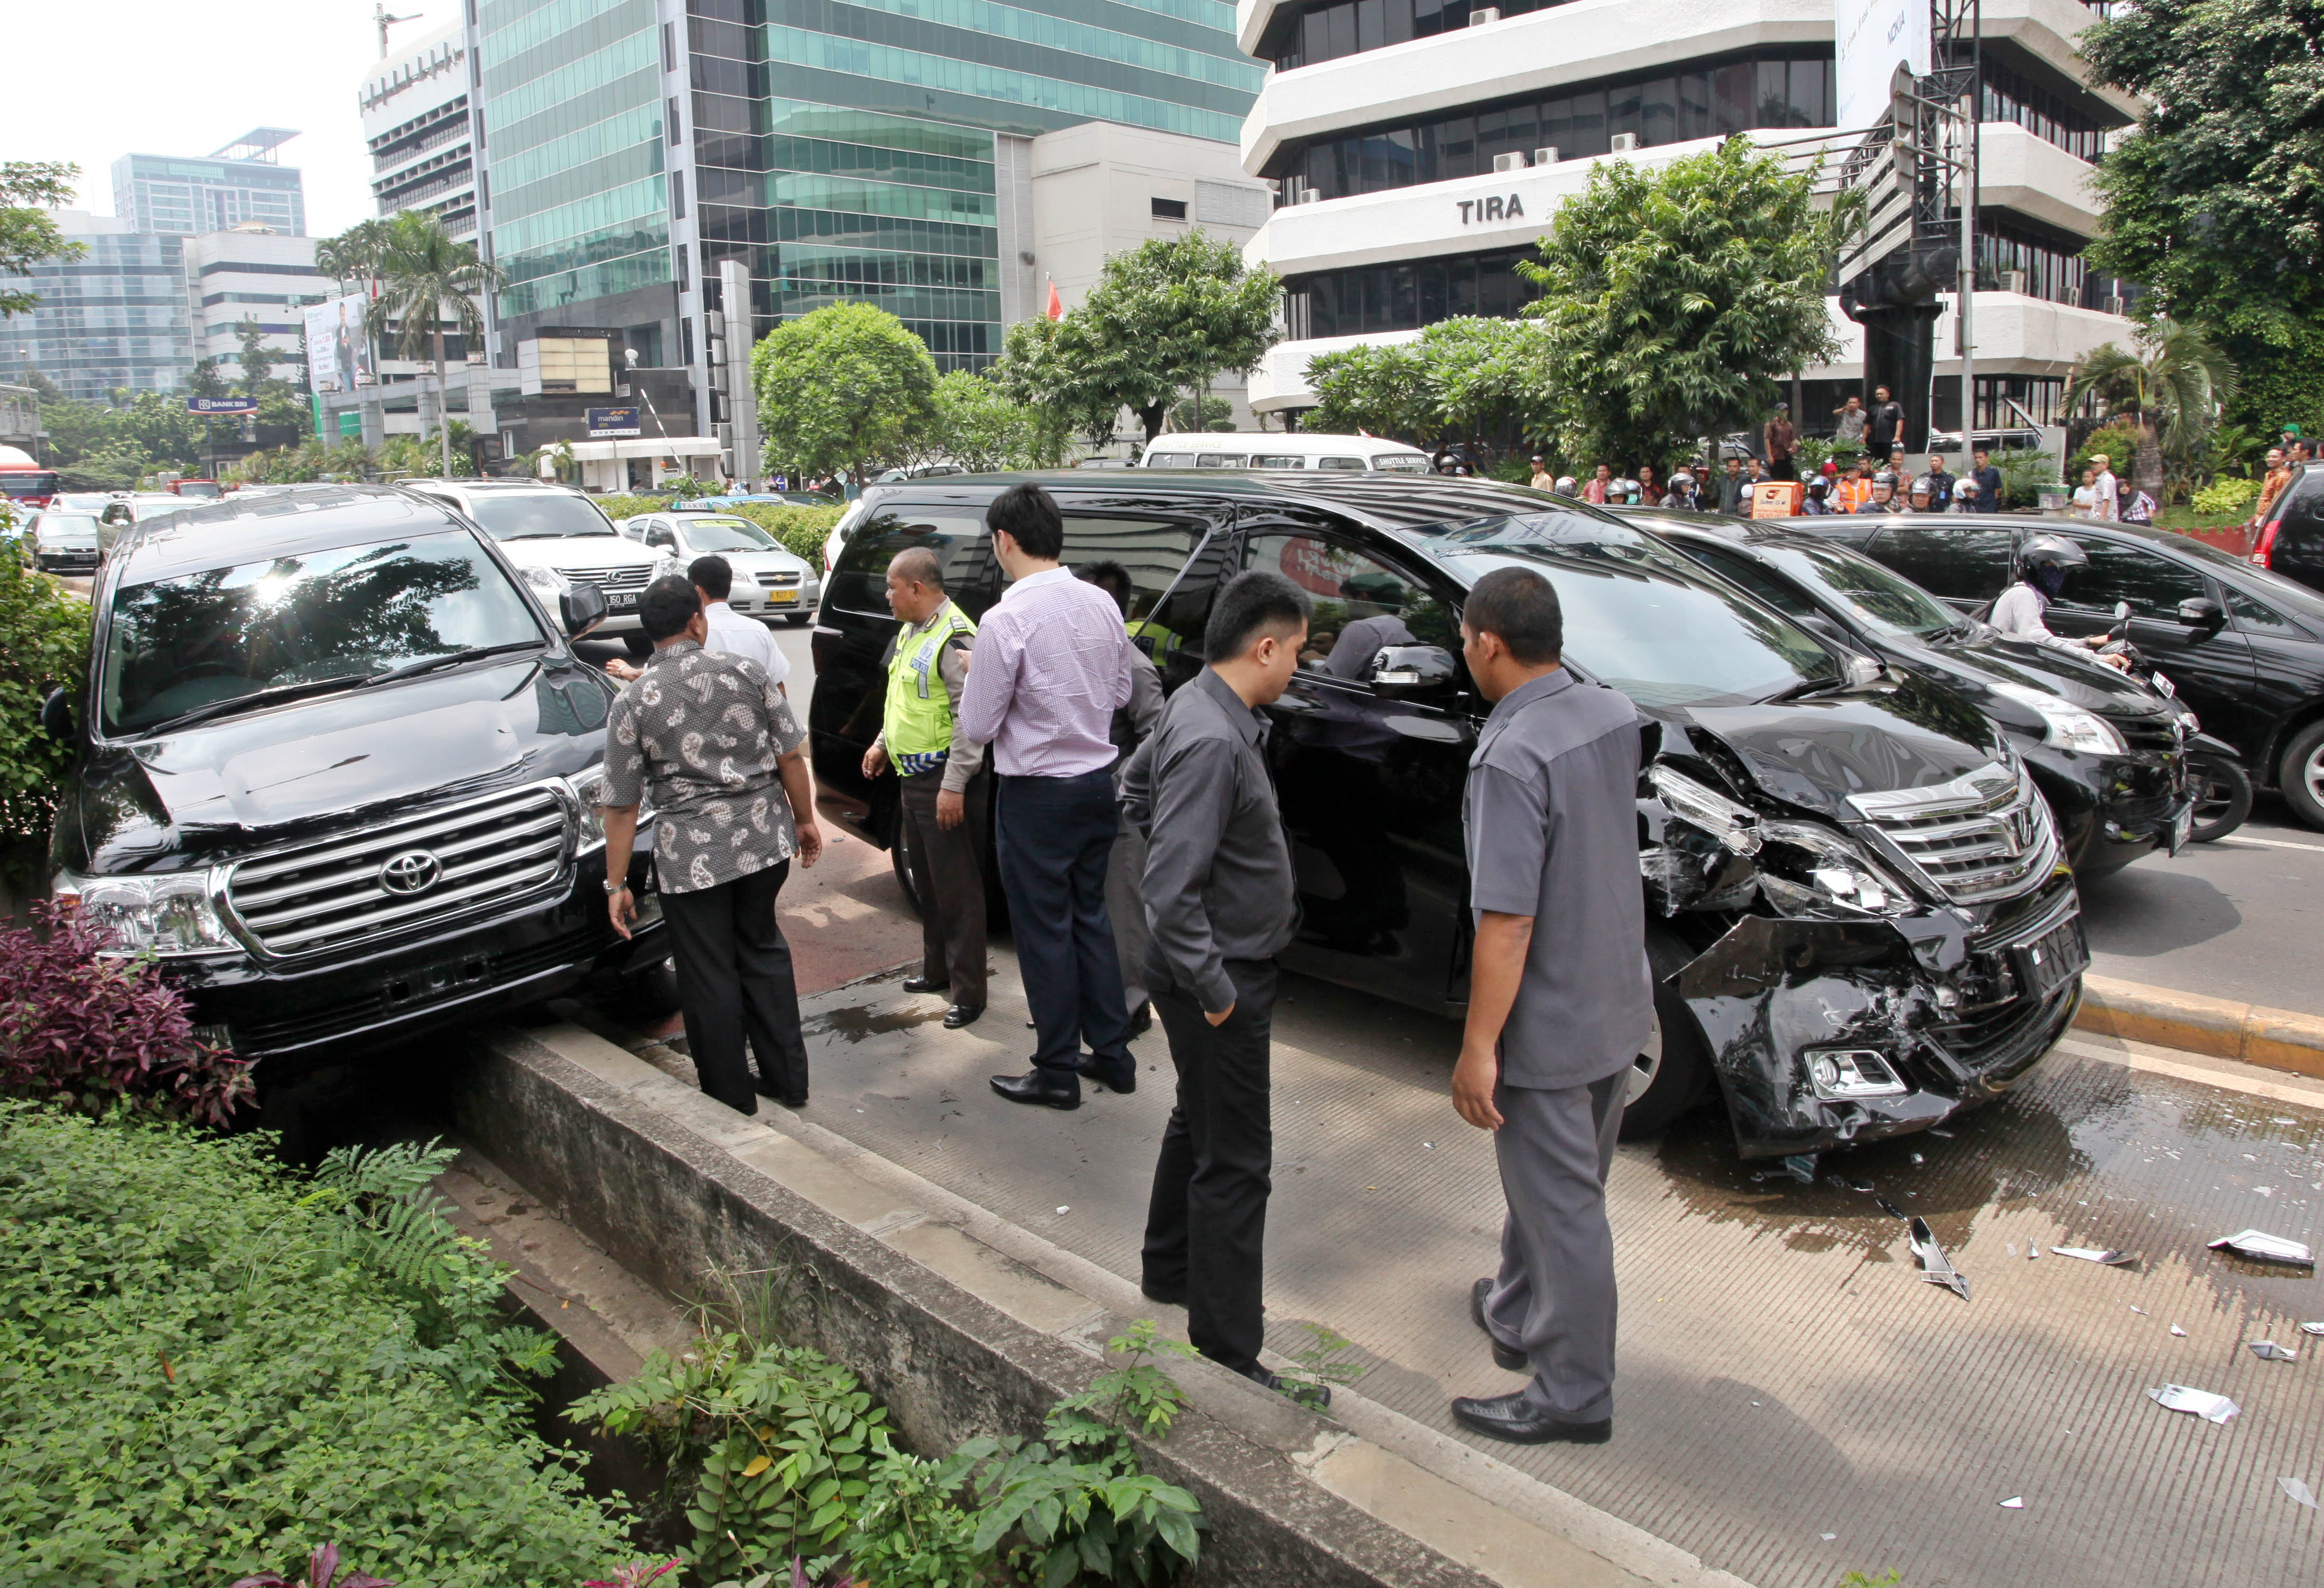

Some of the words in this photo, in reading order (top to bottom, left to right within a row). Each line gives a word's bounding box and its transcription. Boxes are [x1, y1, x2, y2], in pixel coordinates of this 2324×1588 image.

[1888, 9, 1905, 48] NOKIA
[1456, 193, 1524, 225] TIRA
[609, 595, 621, 604] 150
[624, 594, 636, 603] RGA
[910, 658, 928, 675] POLISI
